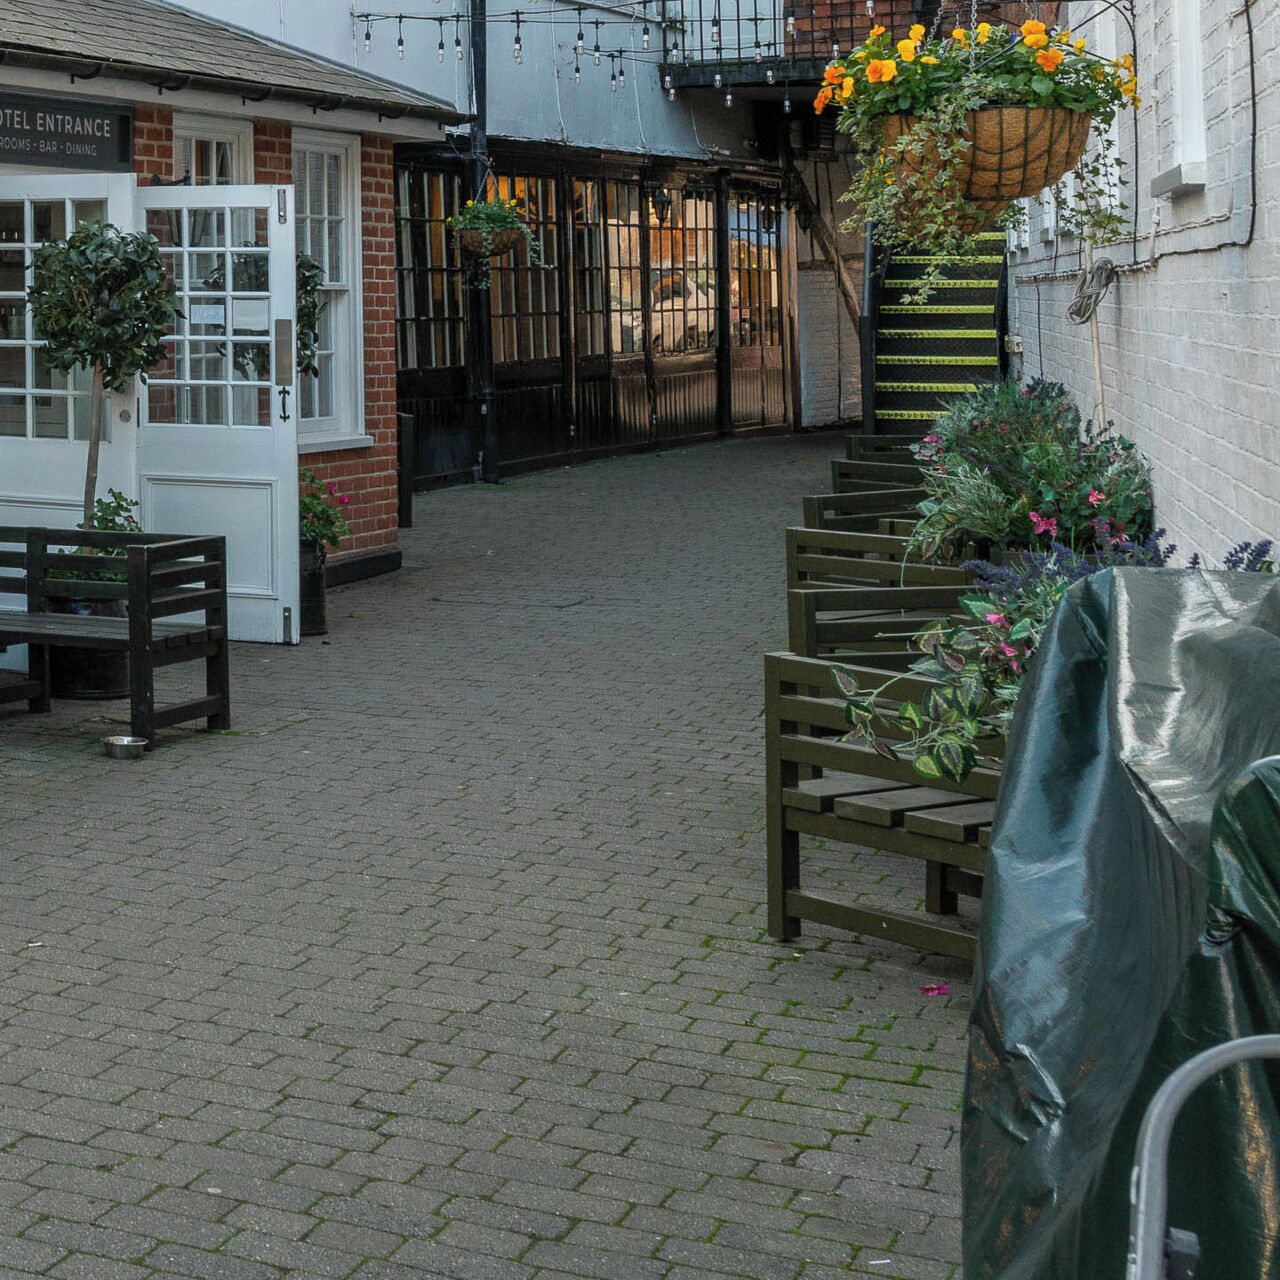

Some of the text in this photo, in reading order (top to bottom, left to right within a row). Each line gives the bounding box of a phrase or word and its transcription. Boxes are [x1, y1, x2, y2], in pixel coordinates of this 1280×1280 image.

[36, 112, 111, 137] ENTRANCE
[39, 140, 58, 153] BAR
[65, 142, 97, 156] DINING
